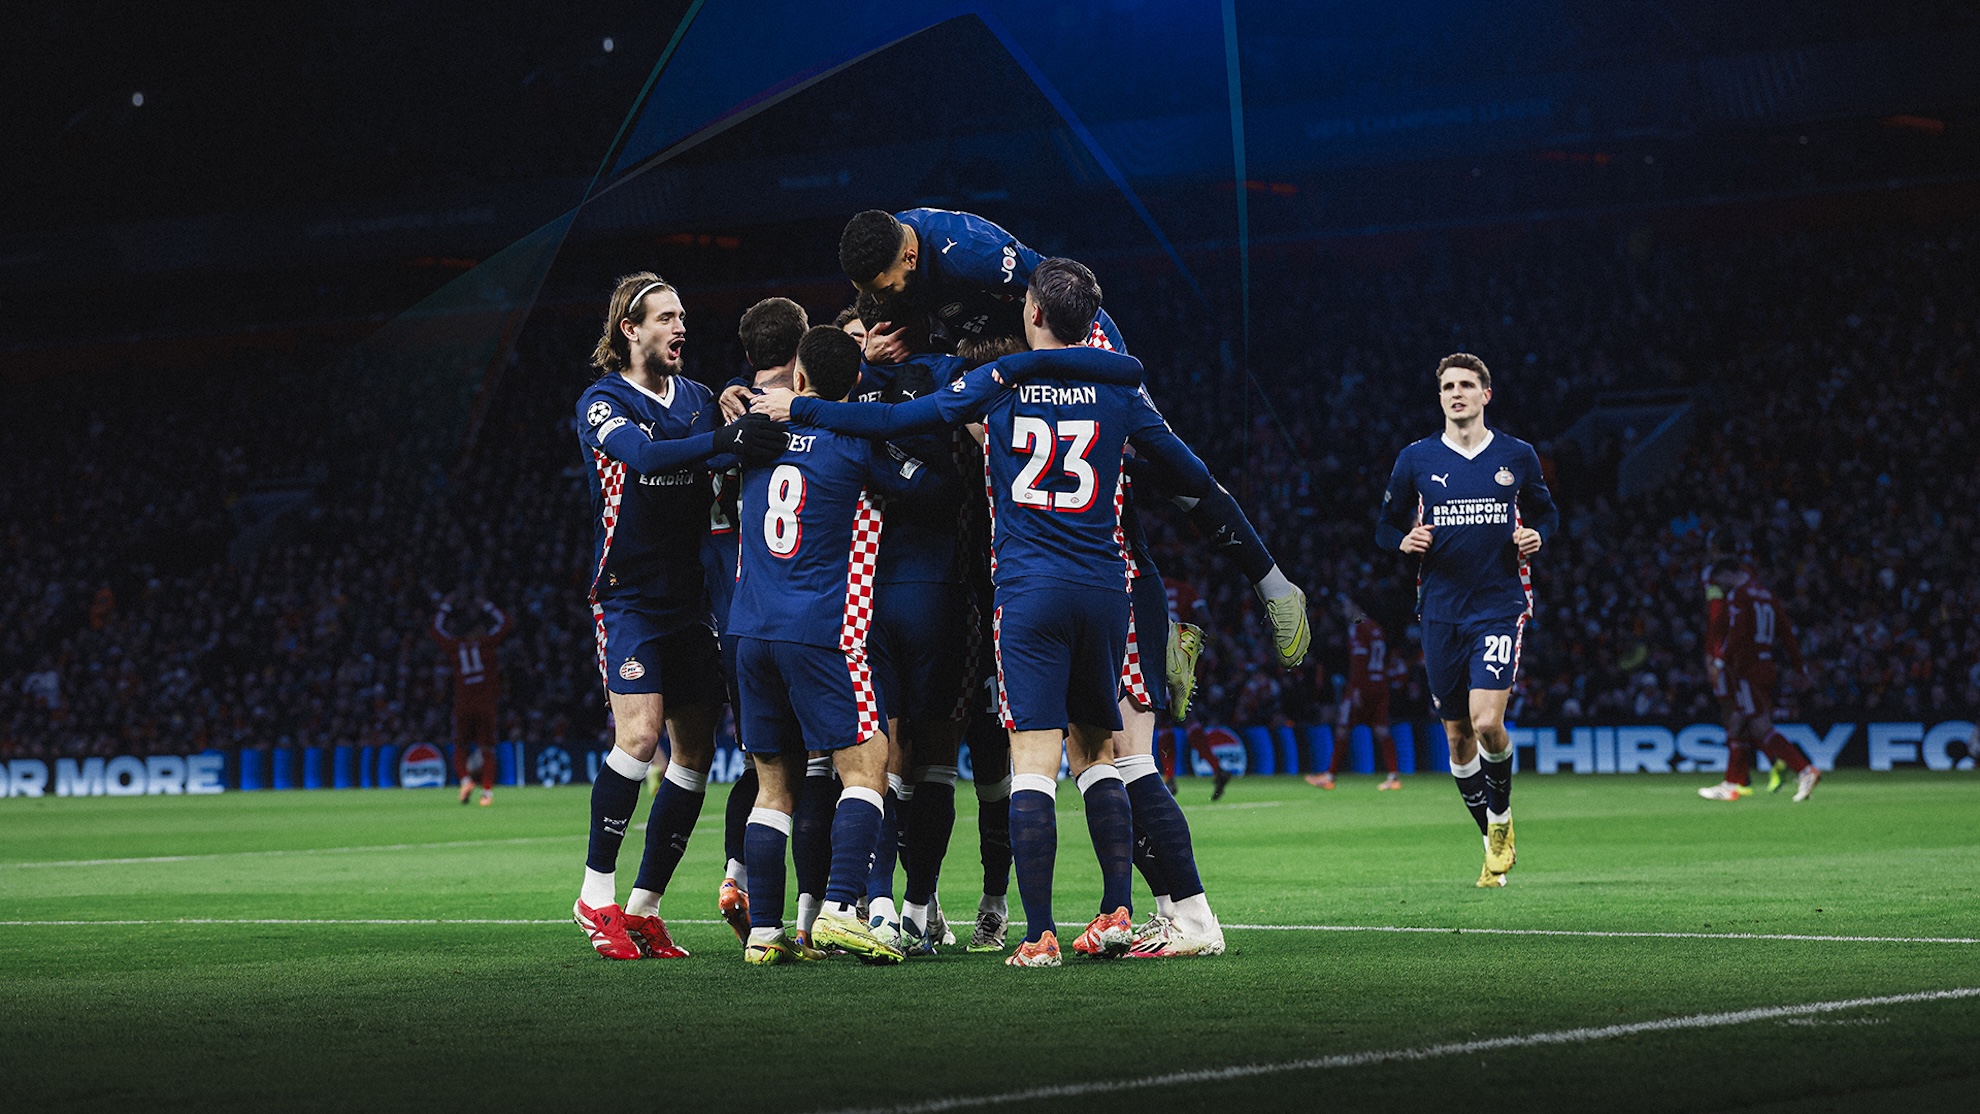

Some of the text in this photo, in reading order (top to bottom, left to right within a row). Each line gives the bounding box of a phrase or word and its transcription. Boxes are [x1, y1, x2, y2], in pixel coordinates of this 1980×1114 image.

[1020, 385, 1097, 405] VEERMAN
[639, 473, 694, 486] EINDHO
[1011, 416, 1100, 513] 23
[764, 464, 808, 559] 8
[1433, 503, 1509, 516] BRAINPORT
[1433, 514, 1508, 527] EINDHOVEN
[458, 642, 485, 676] 11
[1483, 634, 1513, 665] 20
[1506, 722, 1857, 774] THIRSY
[0, 754, 226, 798] R MORE
